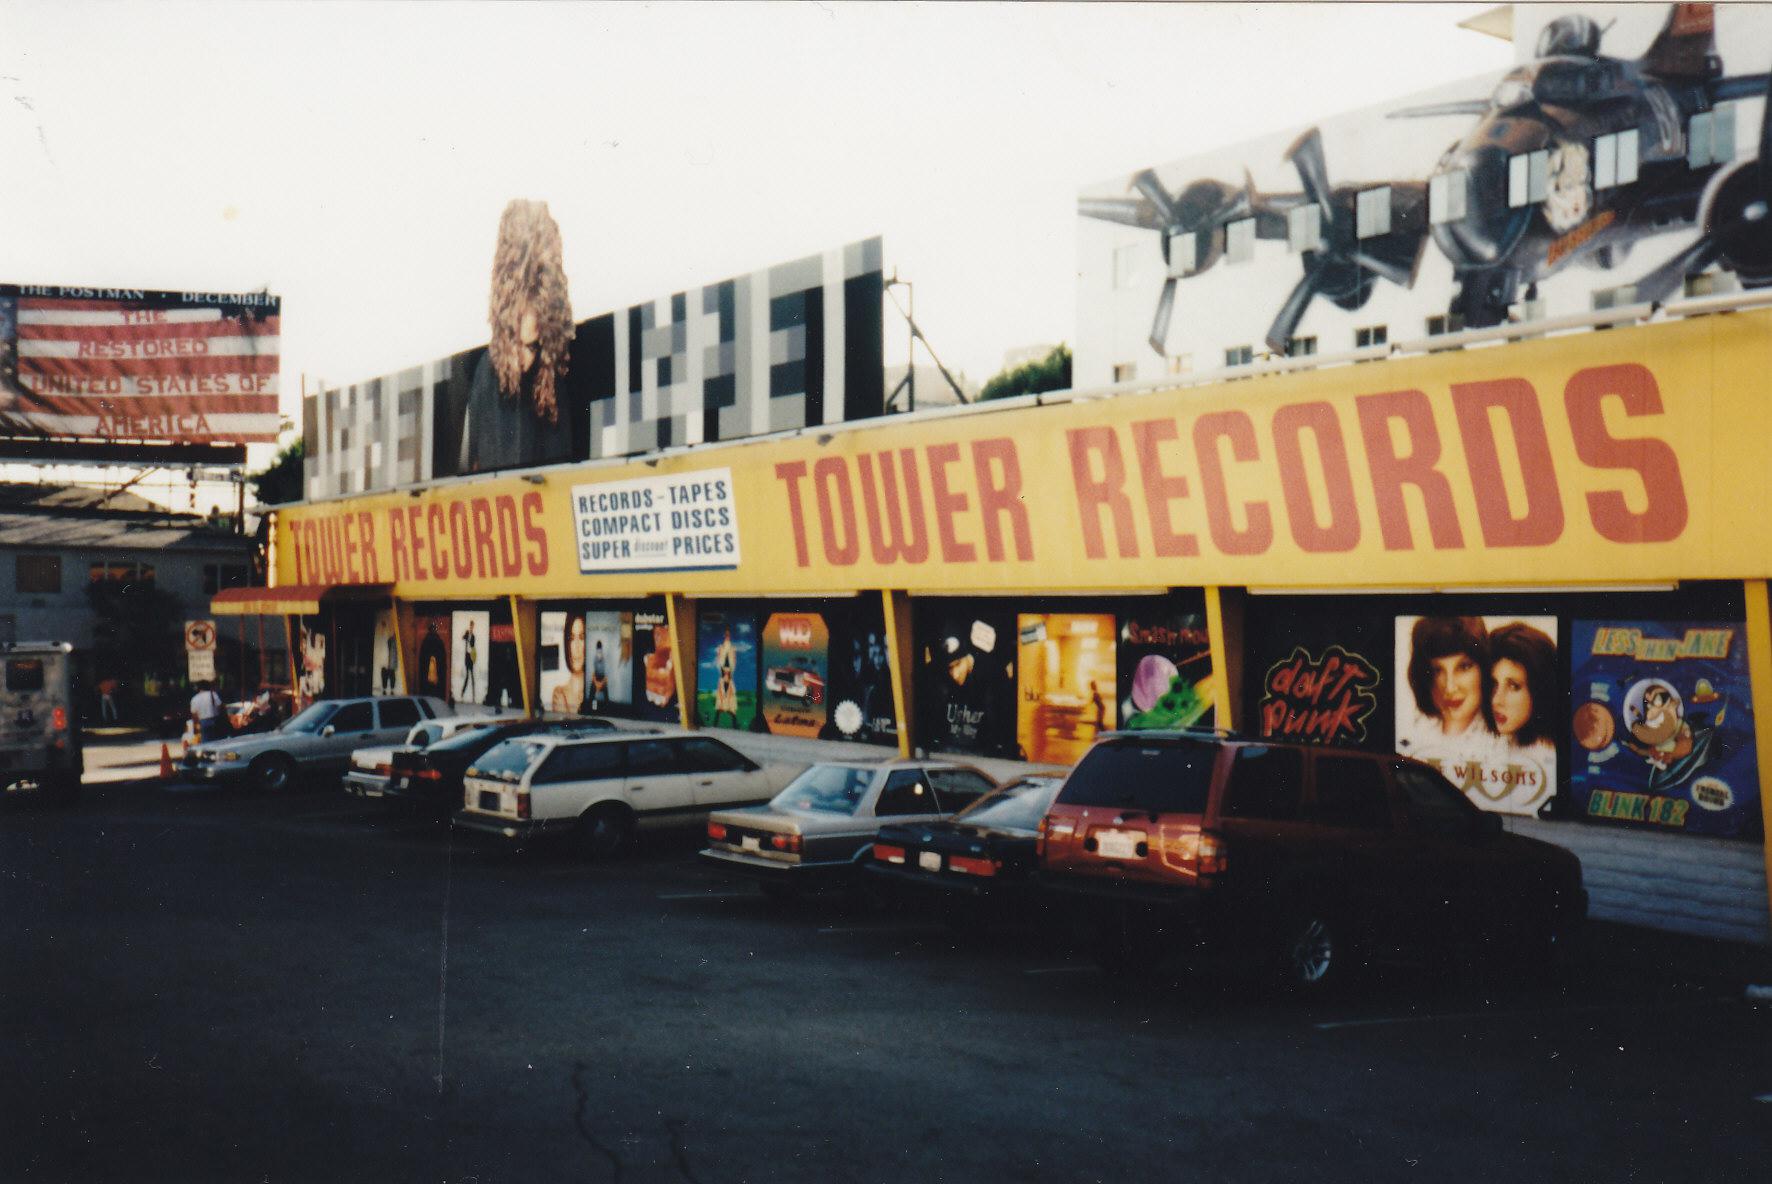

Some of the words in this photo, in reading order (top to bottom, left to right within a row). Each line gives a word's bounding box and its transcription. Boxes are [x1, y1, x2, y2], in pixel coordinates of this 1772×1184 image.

[20, 285, 51, 296] THE
[59, 287, 144, 300] POSTMAN
[182, 292, 276, 306] DECEMBER
[121, 310, 168, 324] THE
[78, 340, 209, 358] RESTORED
[30, 376, 121, 394] UNITED
[136, 376, 230, 393] STATES
[240, 377, 271, 392] OF
[97, 415, 210, 434] AMERICA
[776, 435, 1034, 567] TOWER
[1066, 362, 1688, 560] RECORDS
[579, 488, 653, 513] RECORDS
[669, 480, 727, 505] TAPES
[581, 512, 661, 537] COMPACT
[671, 506, 730, 529] DISCS
[289, 511, 379, 584] TOWER
[391, 492, 549, 582] RECORDS
[582, 540, 631, 560] SUPER
[673, 533, 735, 555] PRICES
[1454, 767, 1537, 785] WILSONS
[1588, 790, 1649, 820] BLINK
[1650, 796, 1690, 826] 182
